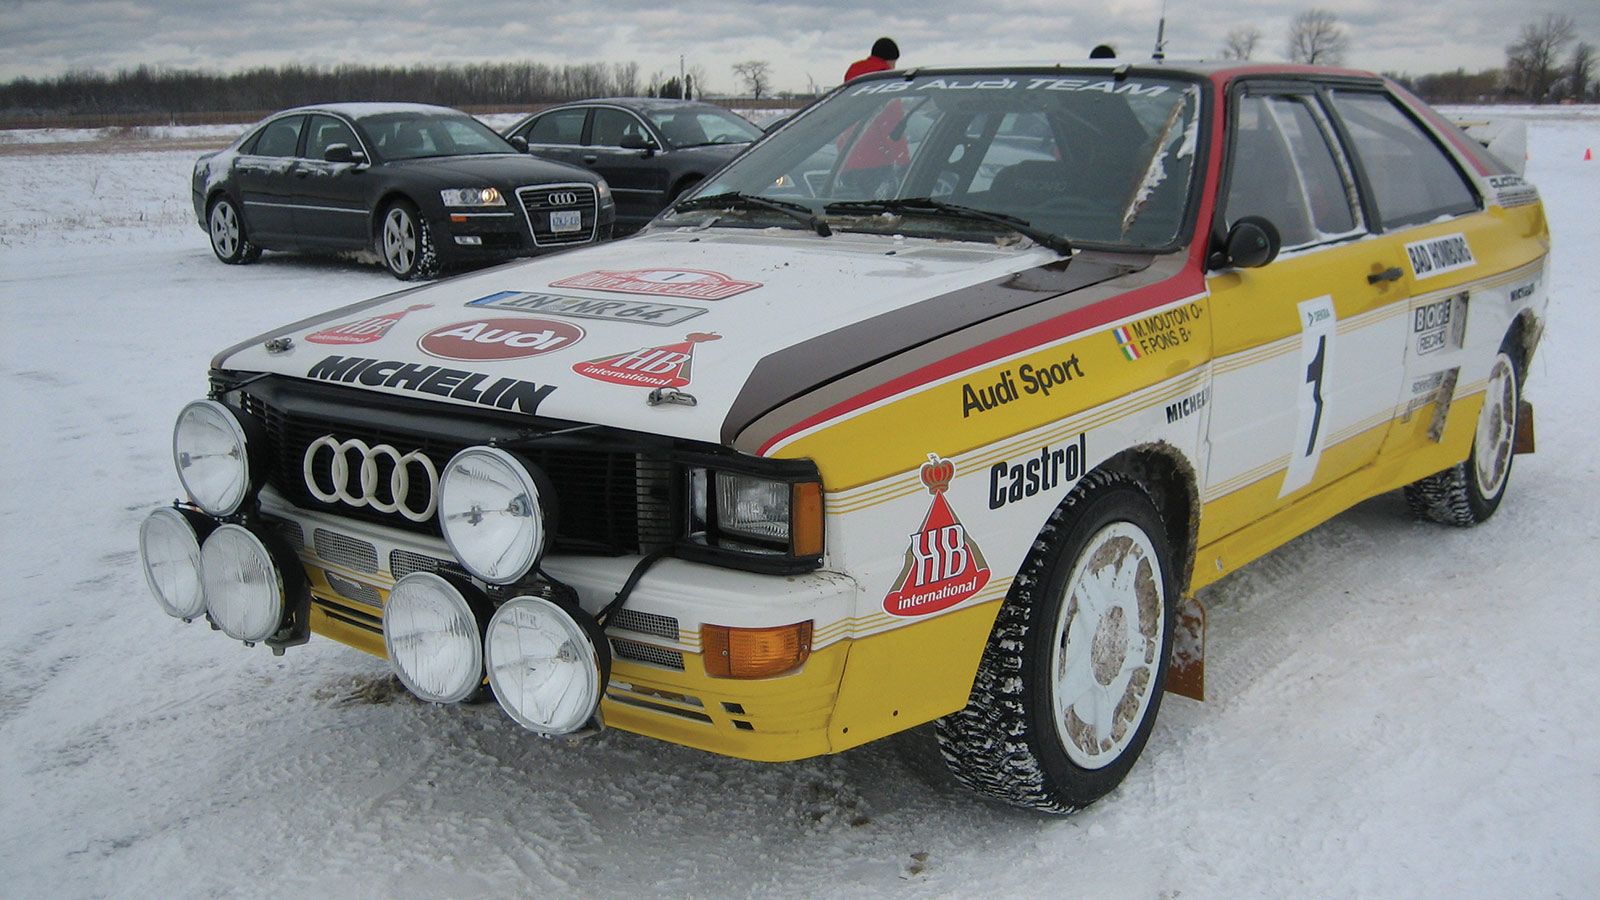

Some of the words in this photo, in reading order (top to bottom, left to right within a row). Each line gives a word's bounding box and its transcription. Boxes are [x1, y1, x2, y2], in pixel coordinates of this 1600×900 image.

[851, 80, 914, 96] HB
[916, 77, 1018, 91] Audi
[1025, 78, 1170, 98] TEAM
[1408, 245, 1432, 274] BAD
[336, 318, 399, 334] HB
[1414, 299, 1452, 332] BOGE
[431, 322, 567, 351] Audi
[583, 365, 673, 386] international
[611, 348, 691, 374] HB
[307, 355, 558, 416] MICHELIN
[962, 369, 1019, 418] Audi
[1019, 353, 1085, 397] Sport
[1305, 334, 1326, 458] 1
[988, 432, 1087, 510] Castrol
[909, 524, 968, 587] HB
[898, 576, 977, 610] international
